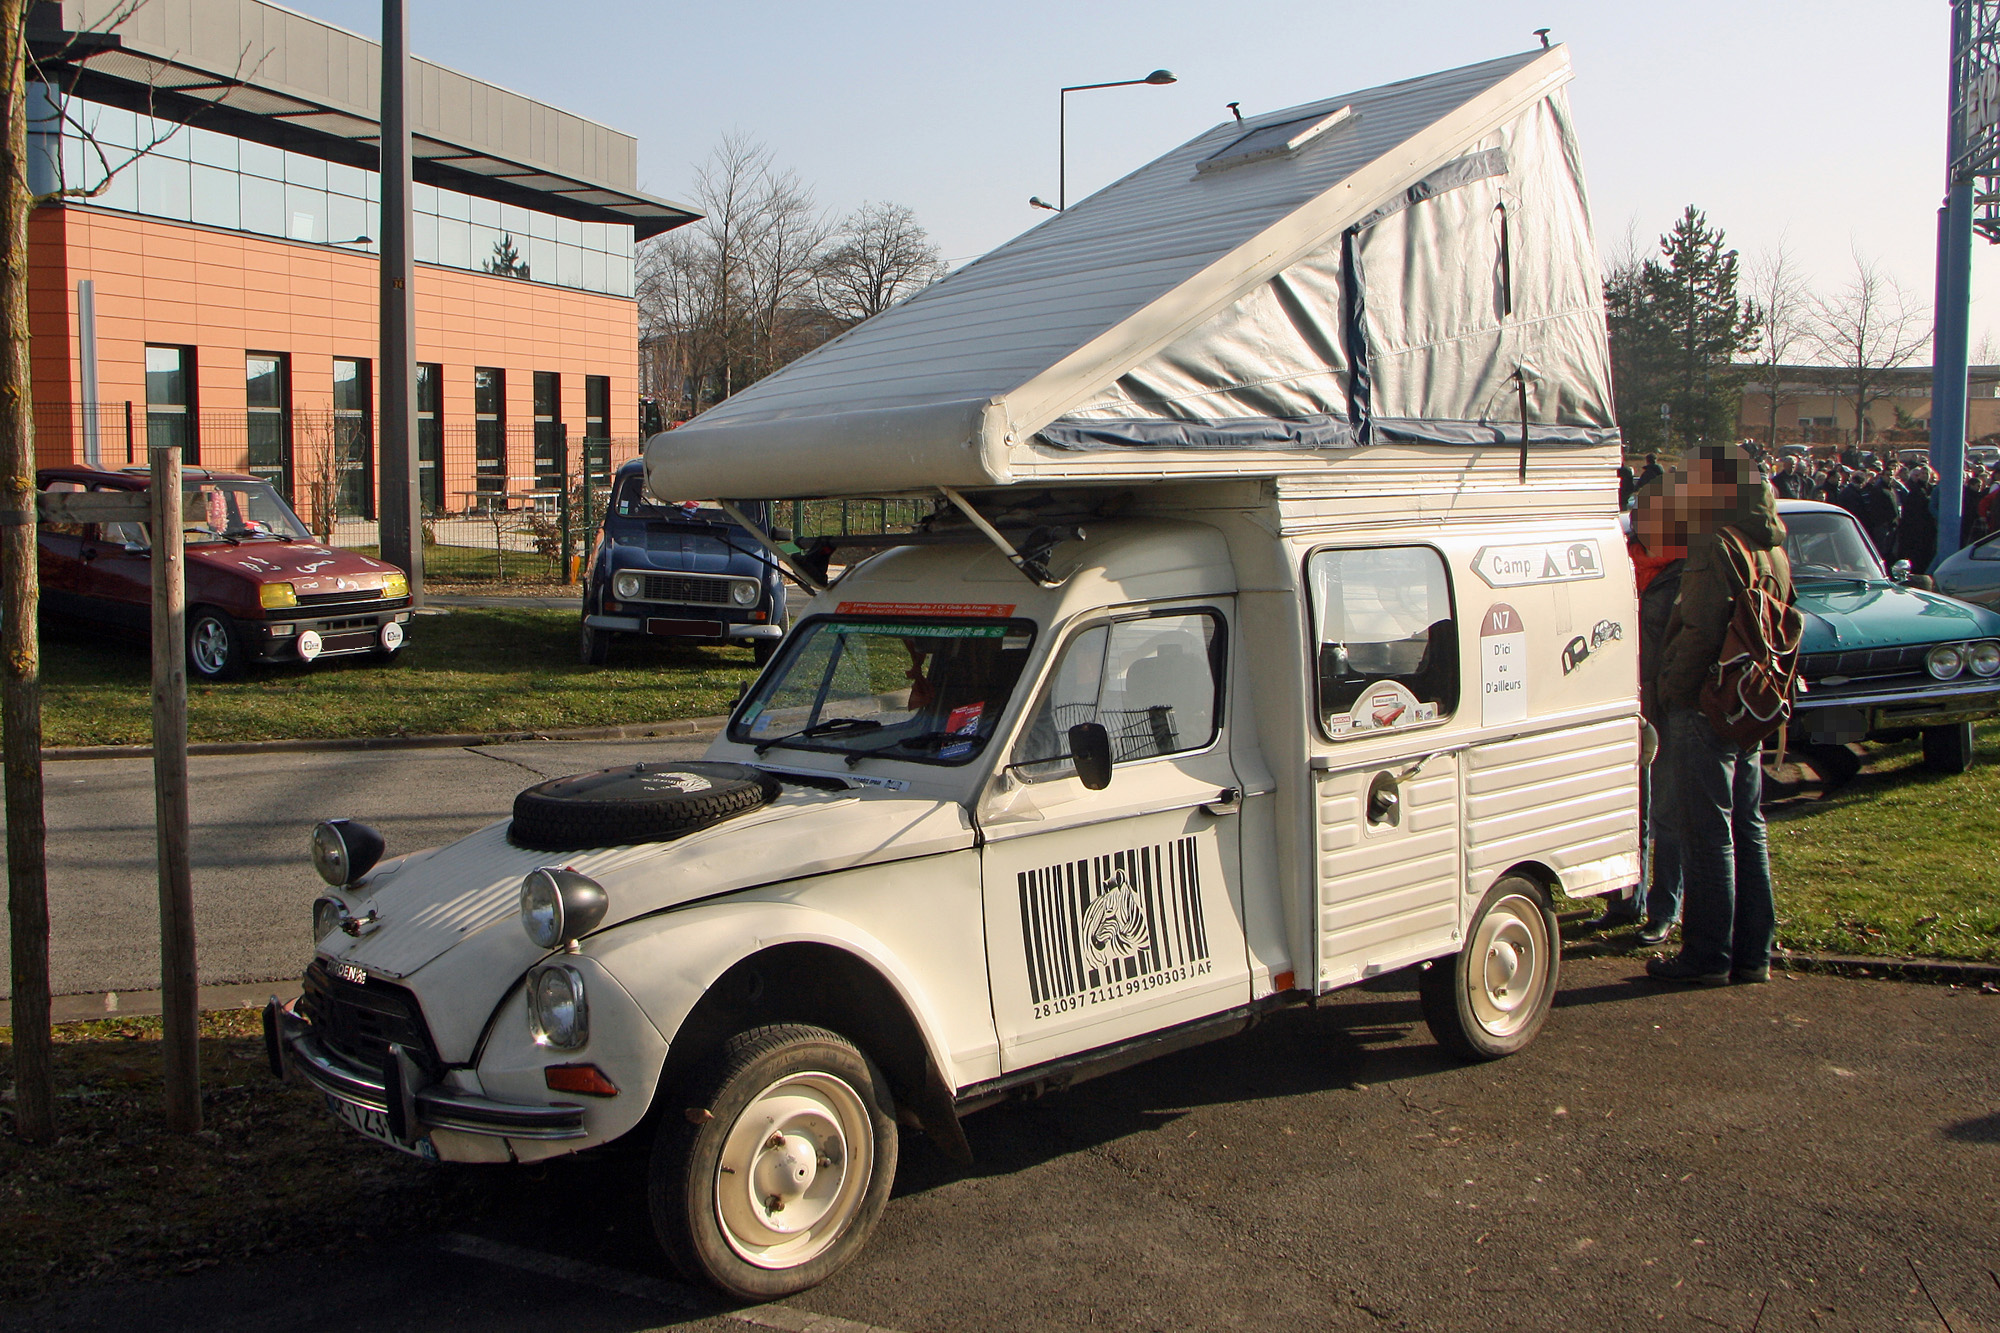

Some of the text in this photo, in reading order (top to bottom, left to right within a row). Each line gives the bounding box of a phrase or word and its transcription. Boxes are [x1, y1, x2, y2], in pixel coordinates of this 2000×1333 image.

[1492, 555, 1531, 578] Camp
[1492, 610, 1510, 631] N7
[1494, 642, 1511, 656] D'ici
[1498, 664, 1508, 673] ou
[1485, 679, 1521, 693] D'ailleurs
